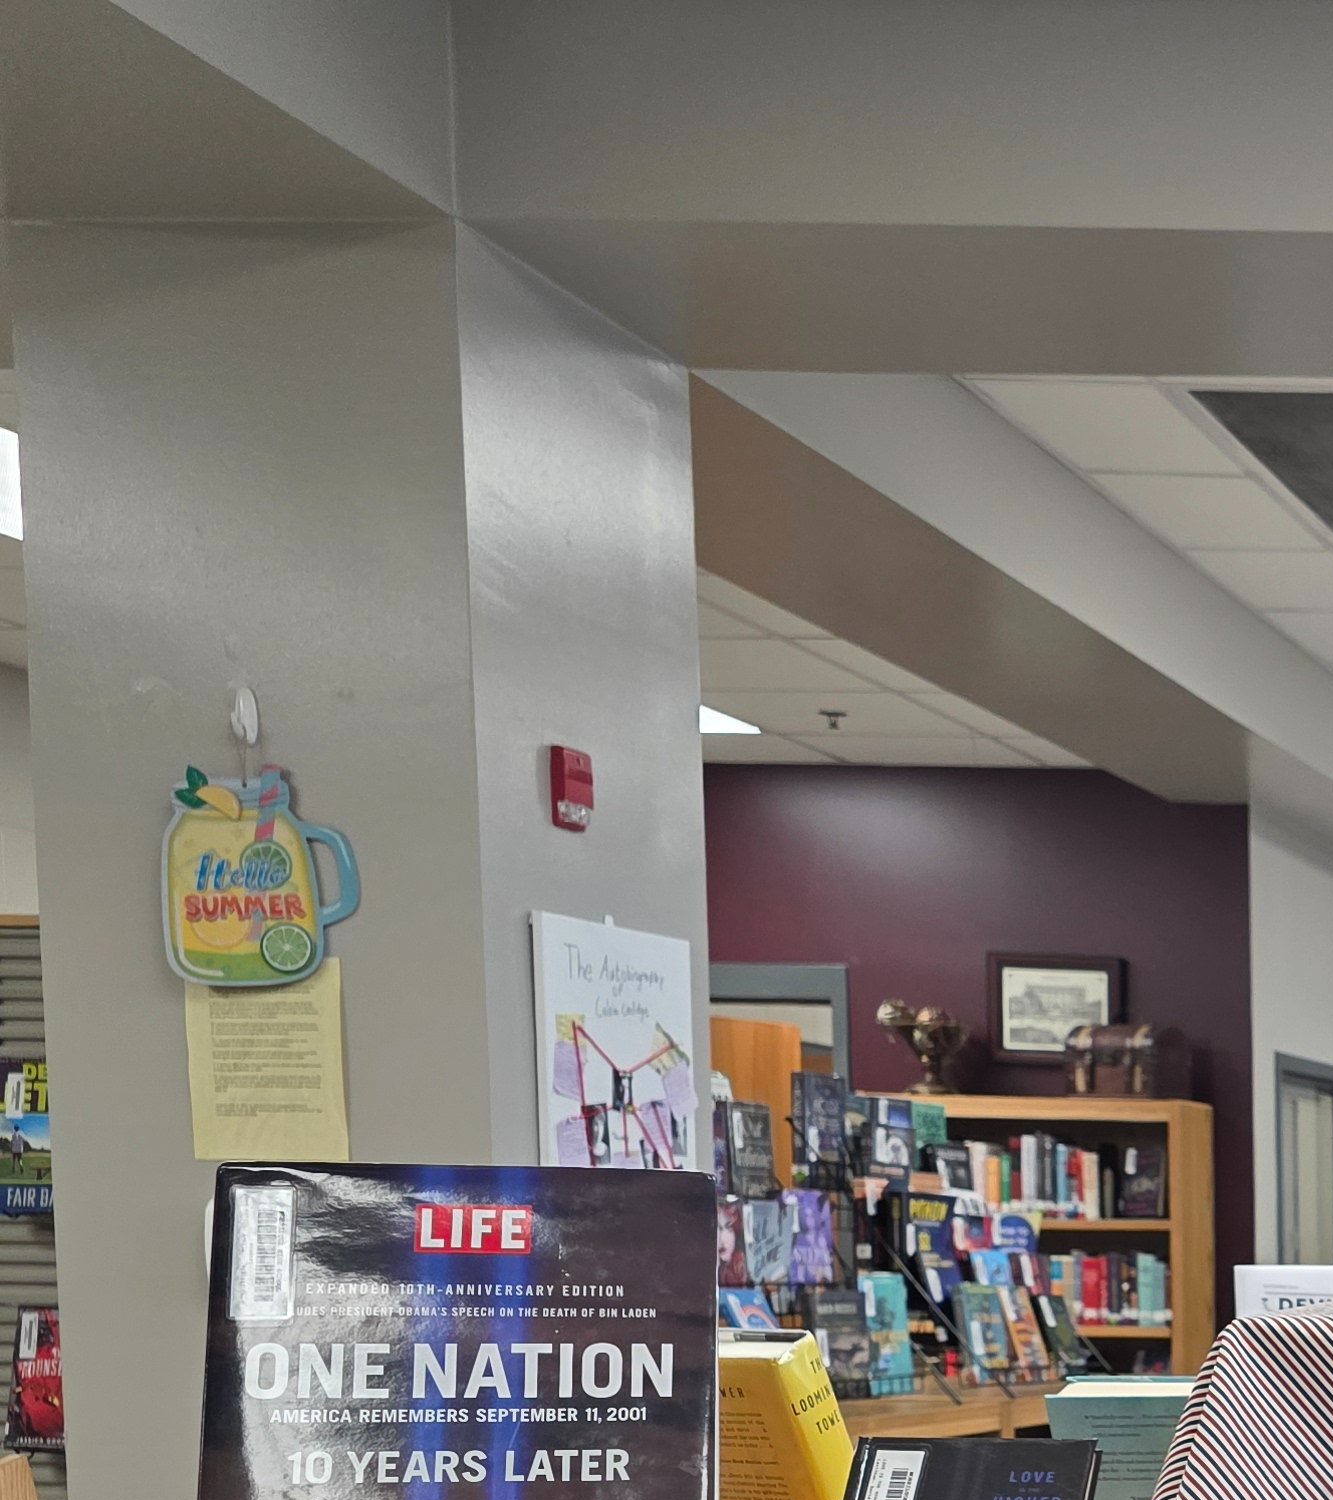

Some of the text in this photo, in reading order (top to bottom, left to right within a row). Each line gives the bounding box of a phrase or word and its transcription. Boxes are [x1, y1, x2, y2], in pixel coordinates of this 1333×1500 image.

[195, 853, 288, 891] Hello
[184, 893, 307, 922] SUMMER
[564, 943, 593, 982] The
[7, 1187, 36, 1207] FAIR
[420, 1209, 526, 1249] LIFE
[306, 1283, 624, 1297] EXPANDED 10TH-ANNIVERSARY EDITION
[330, 1306, 657, 1319] PRESIDENT OBAMA'S SPEECH ON THE DEATH OF BIN LADEN
[244, 1342, 674, 1401] ONE NATION
[271, 1406, 647, 1425] AMERICA REMEMBERS SEPTEMBER 11, 2001
[288, 1449, 630, 1485] 10 YEARS LATER
[1010, 1470, 1056, 1485] LOVE
